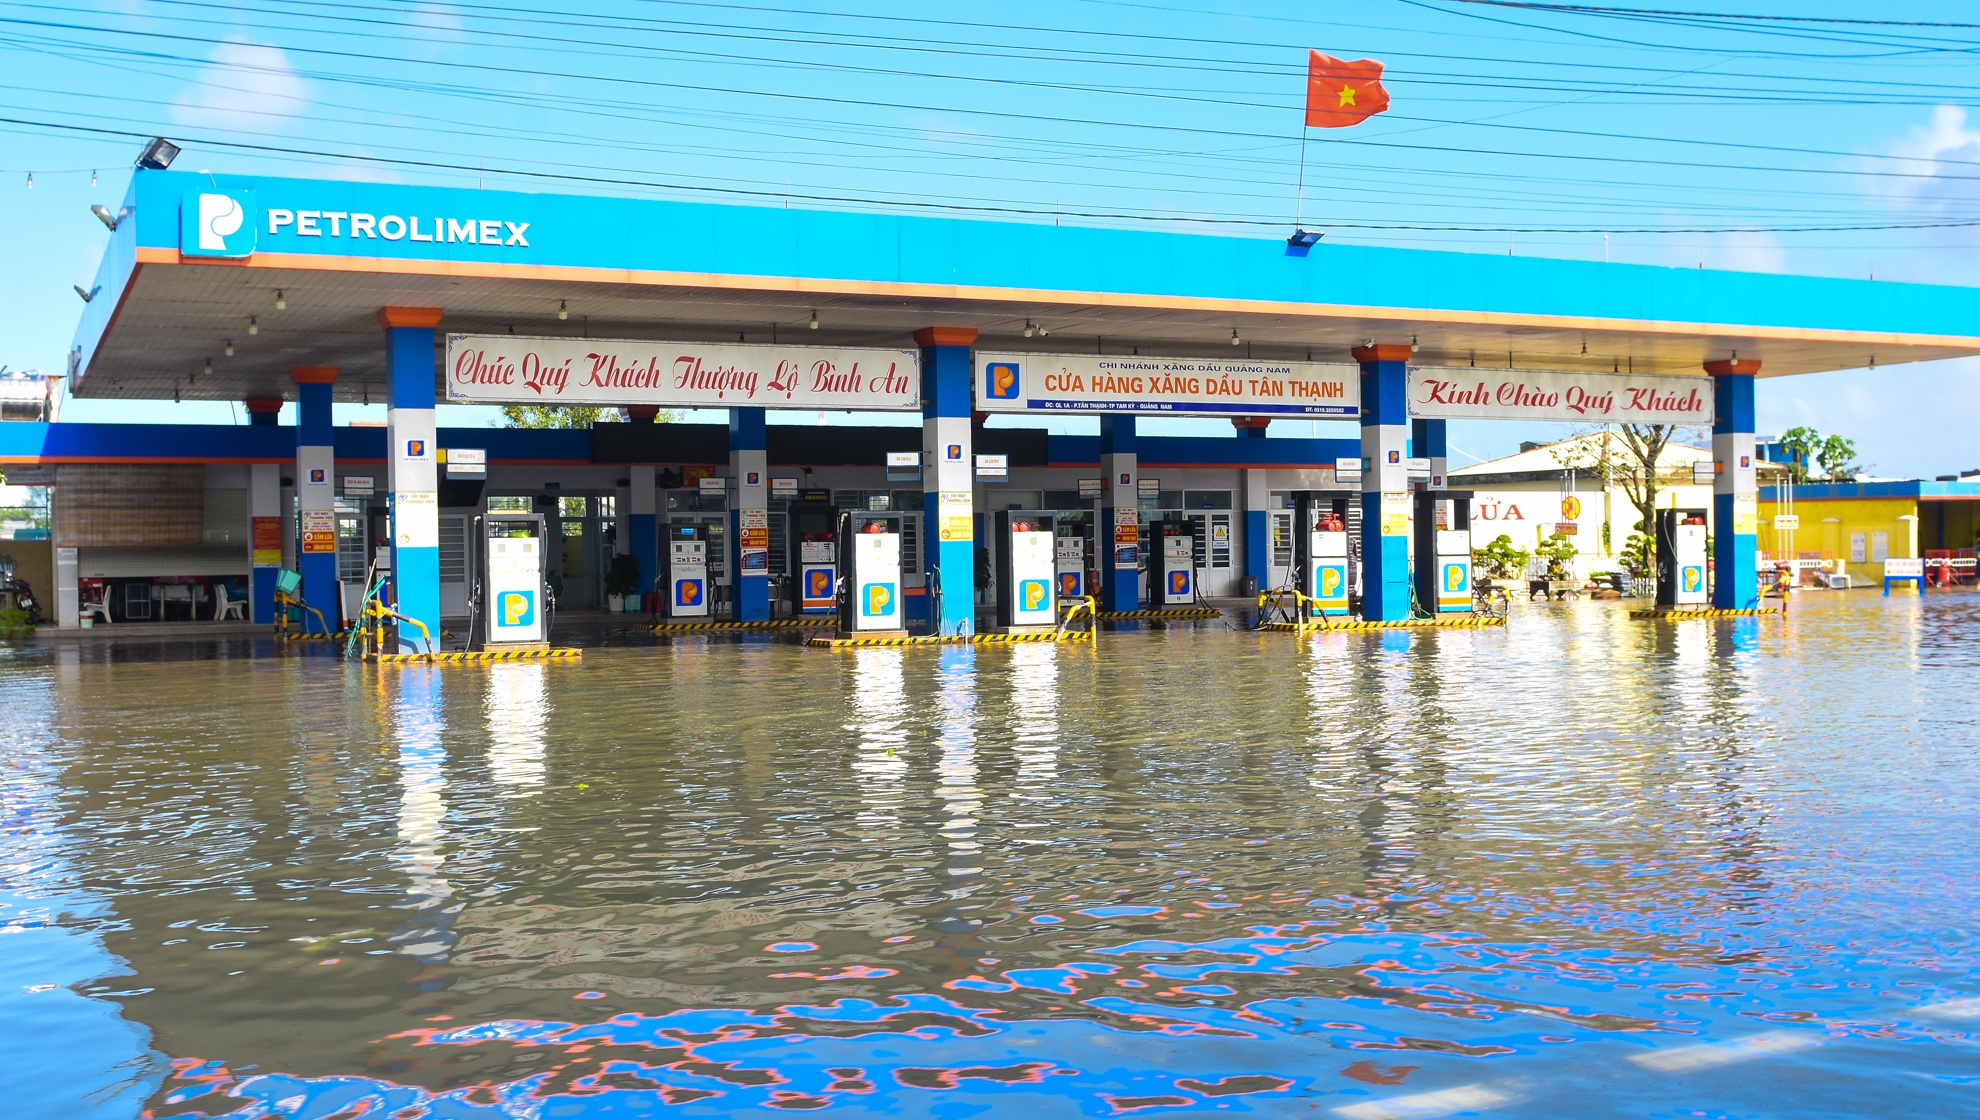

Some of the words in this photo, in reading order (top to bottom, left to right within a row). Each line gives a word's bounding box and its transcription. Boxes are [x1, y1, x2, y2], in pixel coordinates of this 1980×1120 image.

[267, 208, 530, 247] PETROLIMEX
[455, 348, 515, 385] Chúc
[521, 352, 573, 396] Quý
[578, 352, 662, 389] Khách
[672, 355, 760, 400] Thượng
[766, 359, 800, 400] Lộ
[810, 359, 862, 394] Bình
[868, 362, 910, 394] An
[1044, 367, 1085, 393] CỬA
[1091, 372, 1143, 394] HÀNG
[1148, 373, 1200, 394] XĂNG
[1206, 372, 1243, 396] DẦU
[1248, 376, 1284, 396] TÂN
[1288, 380, 1344, 402] THẠNH
[1120, 361, 1159, 370] NHÁNH
[1163, 362, 1195, 371] XĂNG
[1224, 363, 1263, 374] QUẢNG
[1266, 366, 1291, 374] NAM
[1416, 379, 1492, 406] Kính
[1496, 381, 1559, 408] Chào
[1565, 385, 1614, 415] Quý
[1620, 387, 1704, 412] Khách
